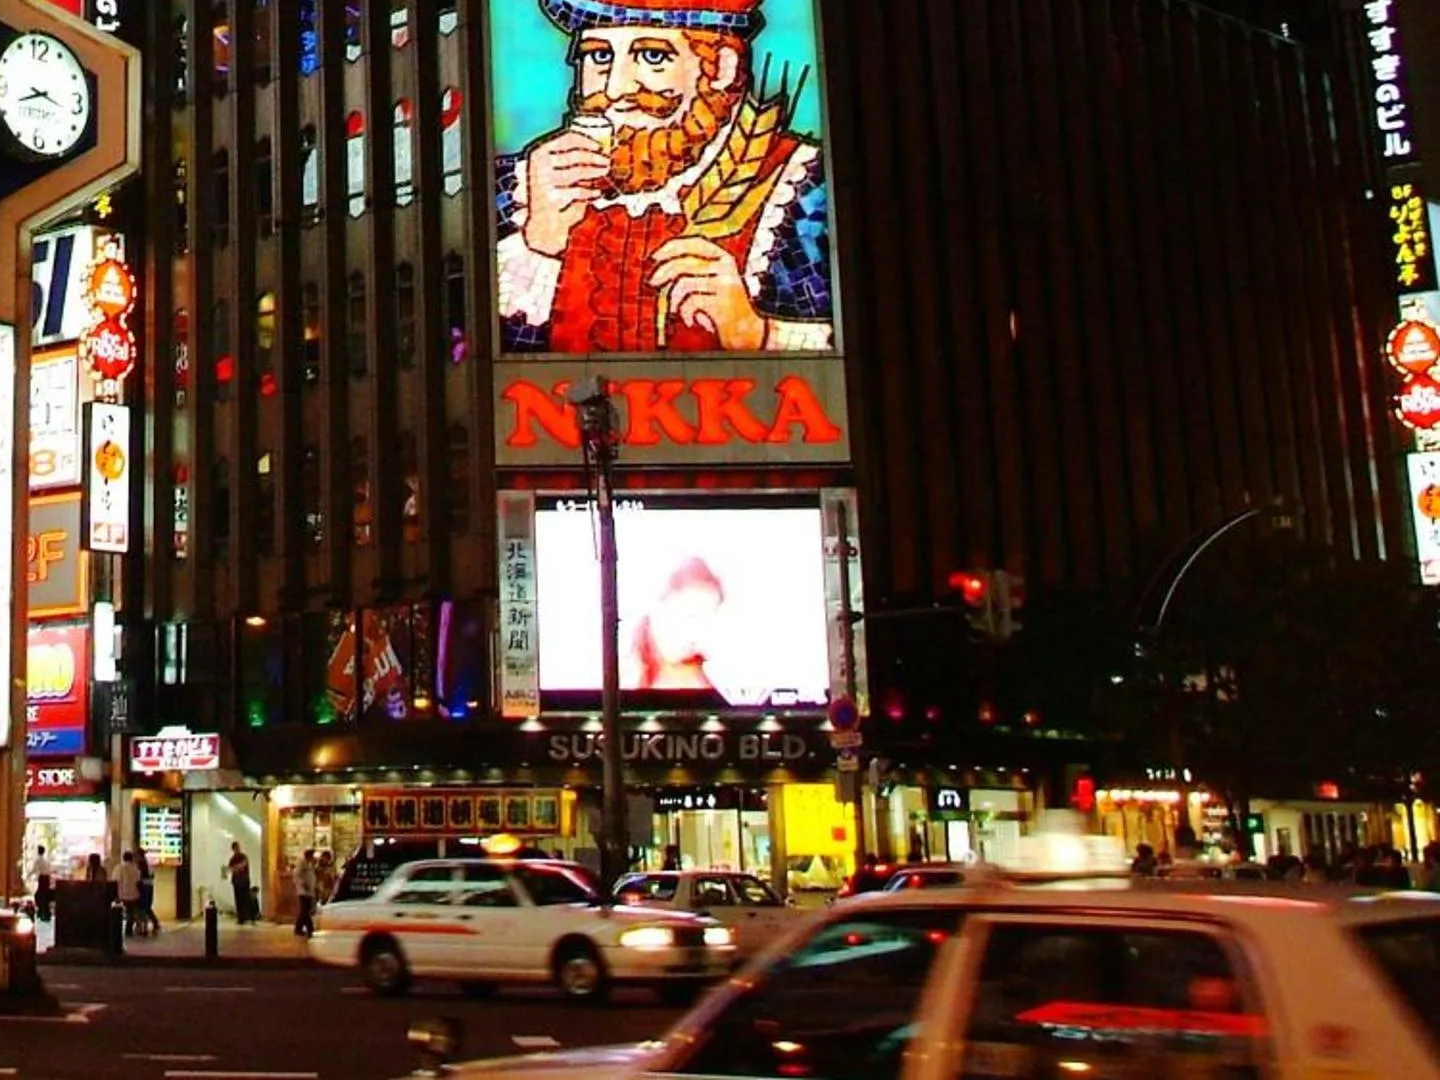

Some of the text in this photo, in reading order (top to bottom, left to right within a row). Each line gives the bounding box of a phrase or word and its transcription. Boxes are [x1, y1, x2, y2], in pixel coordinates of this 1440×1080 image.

[30, 38, 50, 63] 12
[71, 92, 84, 115] 3
[33, 129, 46, 150] 6
[501, 375, 841, 447] NKKA
[506, 541, 532, 651] 北海道新聞
[38, 769, 75, 785] STORE
